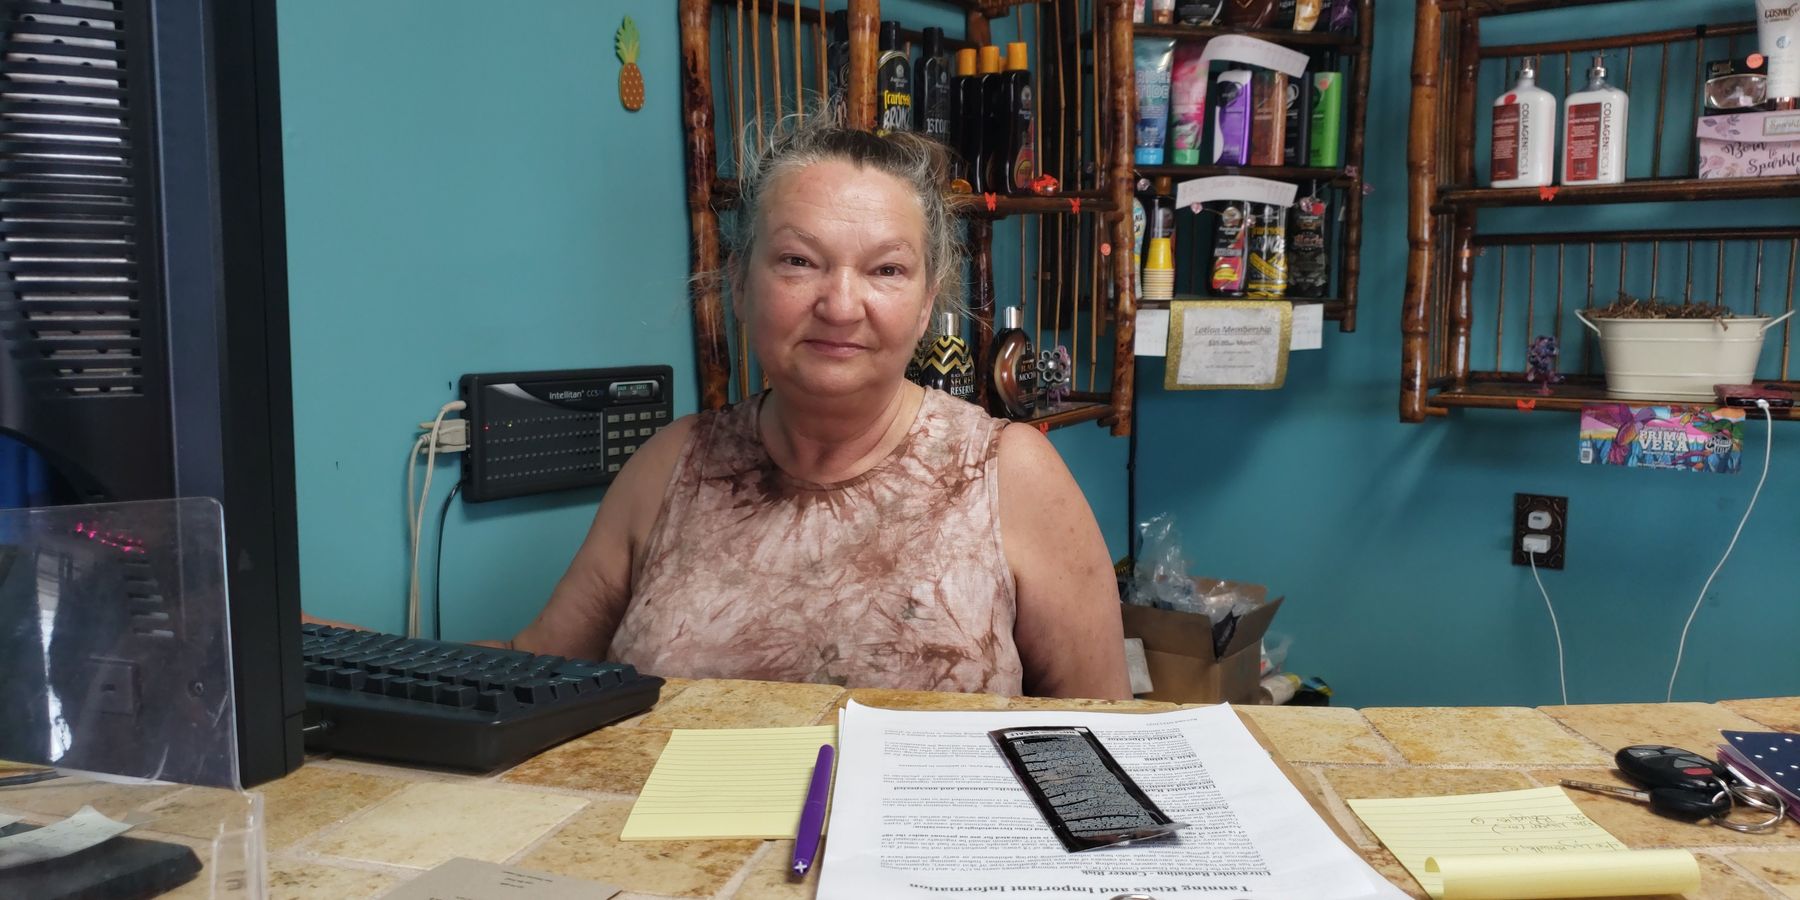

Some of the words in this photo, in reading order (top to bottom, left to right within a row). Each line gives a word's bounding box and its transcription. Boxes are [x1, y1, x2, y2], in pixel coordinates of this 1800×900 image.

[1222, 325, 1273, 337] Membership
[950, 384, 975, 396] RESERVE
[1639, 430, 1687, 441] PRIMA
[1639, 440, 1689, 452] VERA
[1011, 885, 1094, 893] Important
